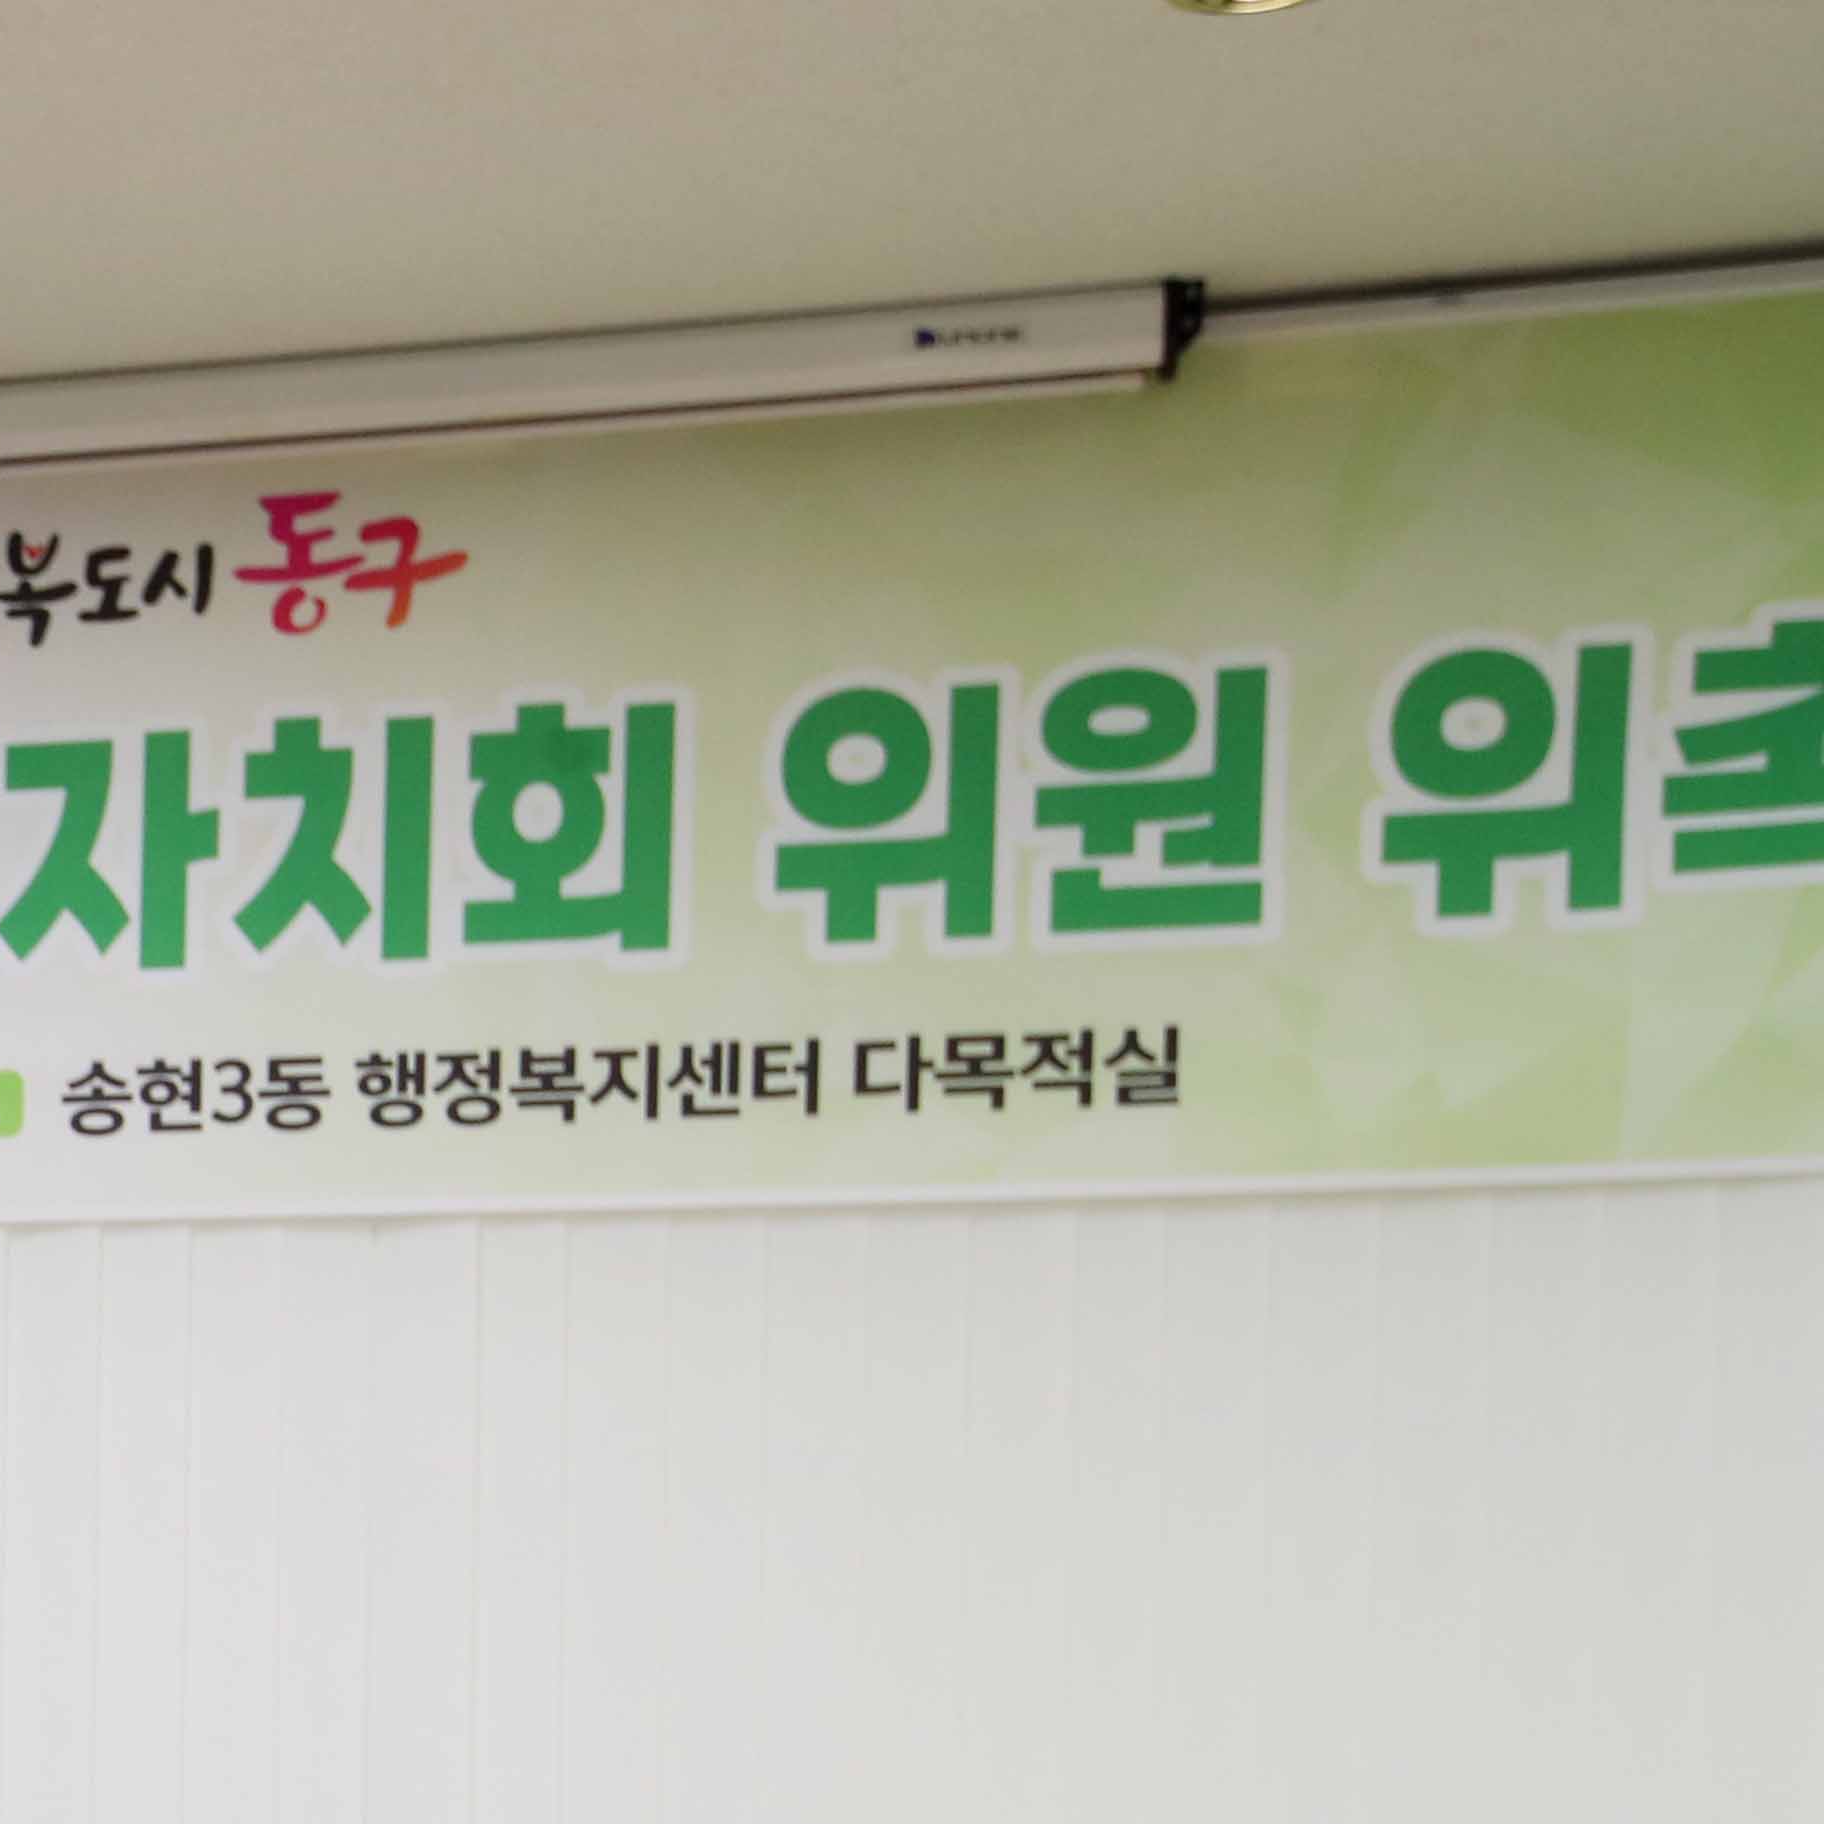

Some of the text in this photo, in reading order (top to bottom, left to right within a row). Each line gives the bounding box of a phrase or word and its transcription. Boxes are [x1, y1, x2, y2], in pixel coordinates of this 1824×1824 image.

[231, 489, 470, 636] 동구
[774, 667, 1268, 944] 위원
[62, 1057, 332, 1136] 송현3동
[355, 1038, 821, 1129] 행정복지센터
[854, 1025, 1182, 1114] 다목적실
